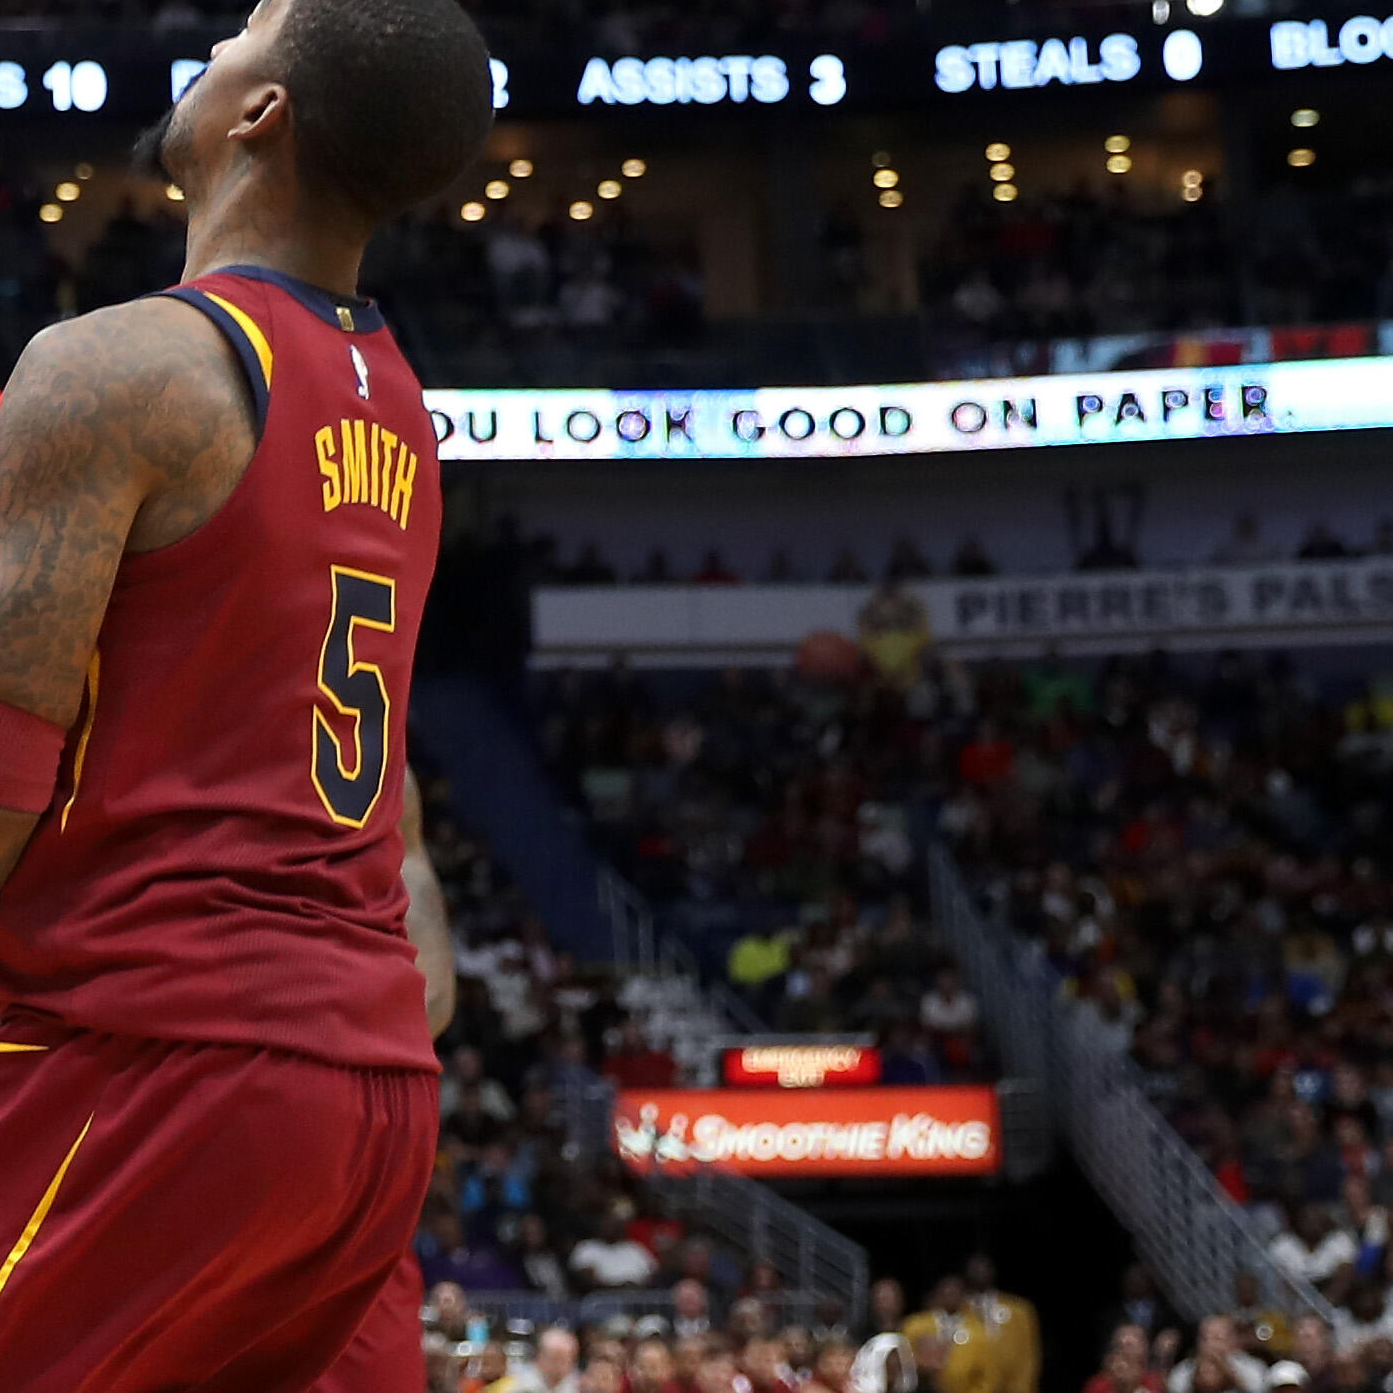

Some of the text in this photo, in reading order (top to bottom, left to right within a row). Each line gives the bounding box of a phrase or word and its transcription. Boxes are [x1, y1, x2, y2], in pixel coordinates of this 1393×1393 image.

[43, 60, 107, 113] 10
[577, 53, 847, 106] ASSISTS 3
[934, 33, 1142, 94] STEALS
[534, 409, 694, 447] LOOK
[731, 405, 911, 443] GOOD
[951, 398, 1038, 434] ON
[314, 418, 417, 531] SMITH
[311, 563, 396, 830] 5
[693, 1114, 886, 1162] SMOOTHIE
